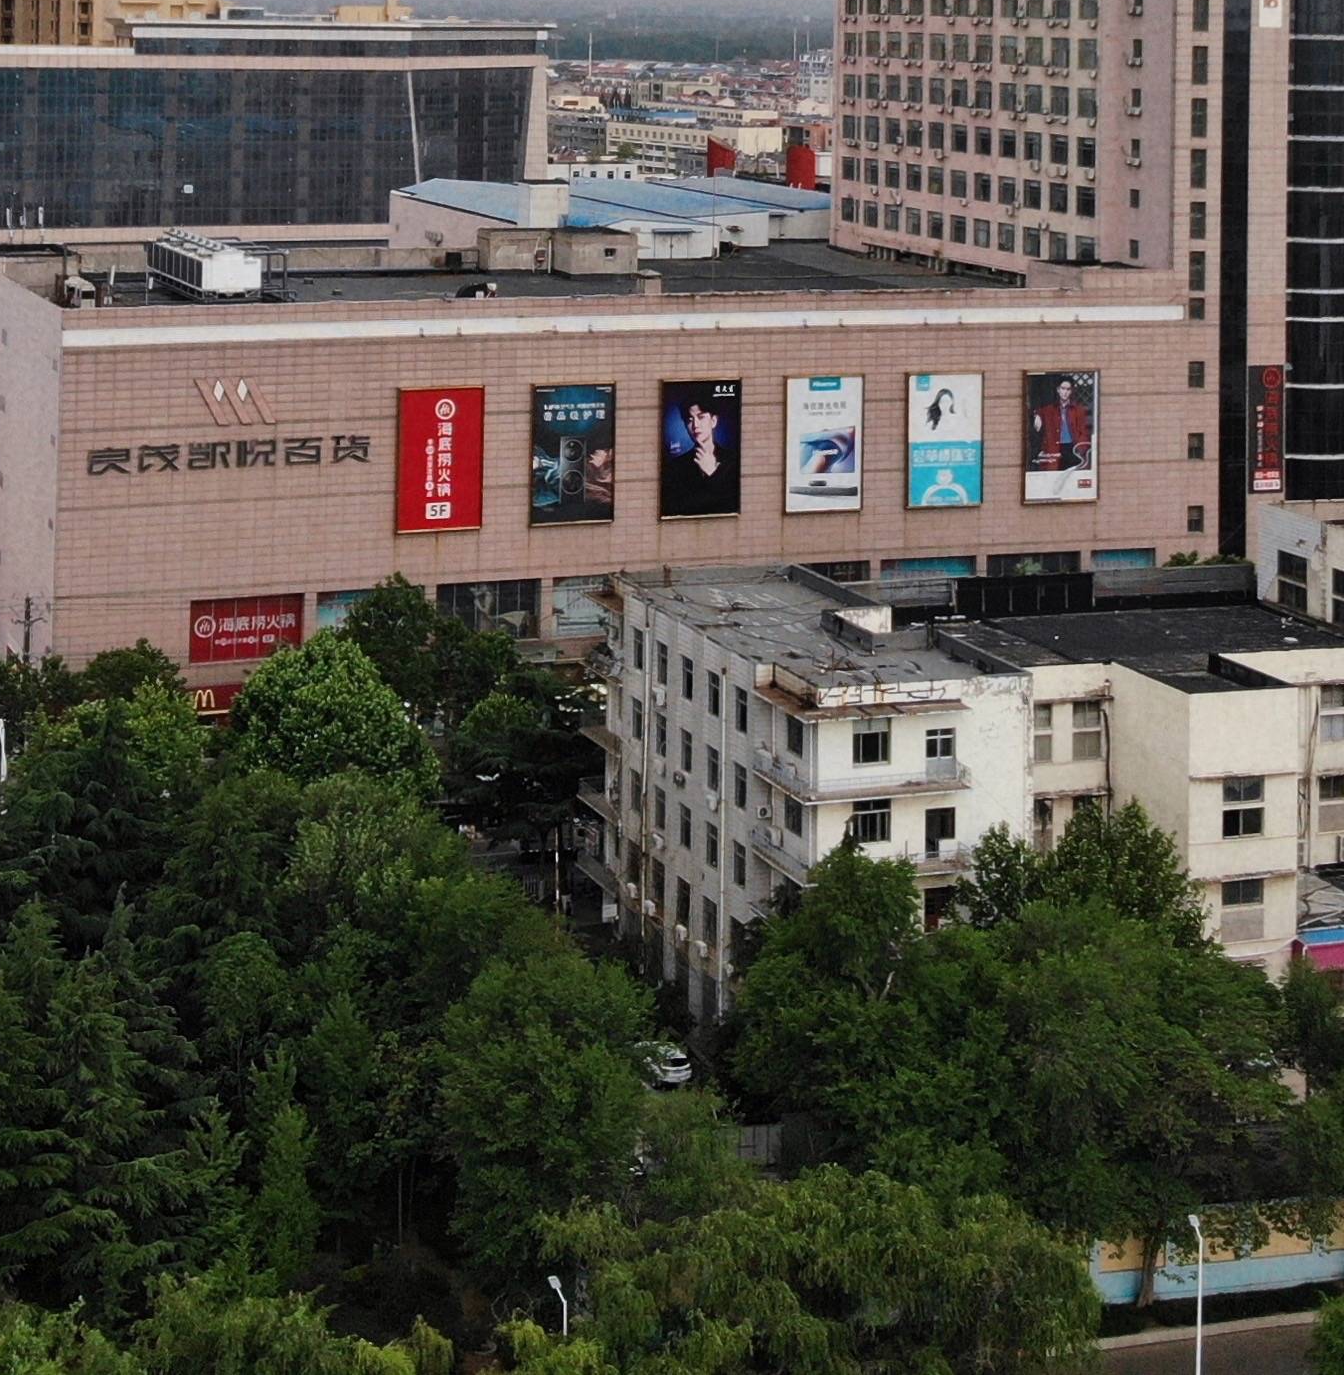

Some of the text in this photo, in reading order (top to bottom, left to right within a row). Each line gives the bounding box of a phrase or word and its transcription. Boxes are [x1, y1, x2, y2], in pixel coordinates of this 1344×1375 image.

[437, 422, 453, 497] 海底捞火锅
[430, 505, 447, 517] 5F
[219, 613, 296, 633] 海底捞火锅
